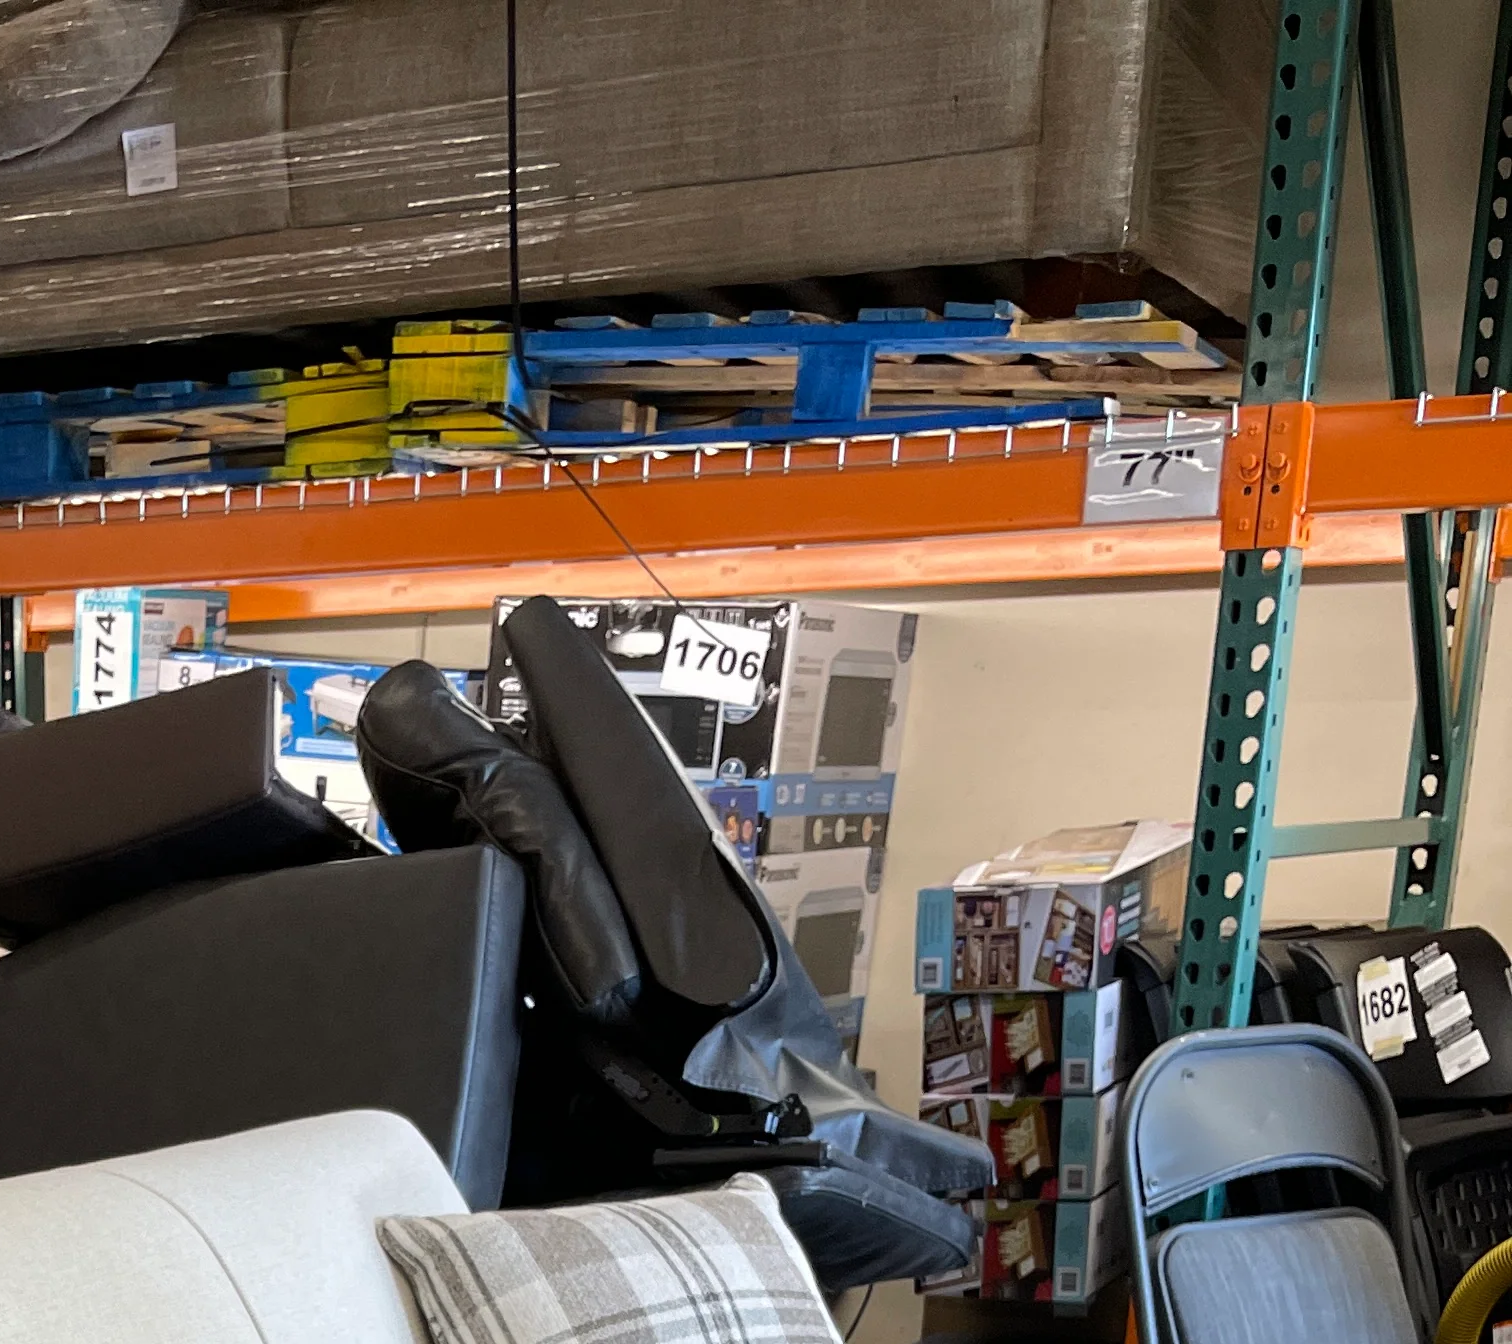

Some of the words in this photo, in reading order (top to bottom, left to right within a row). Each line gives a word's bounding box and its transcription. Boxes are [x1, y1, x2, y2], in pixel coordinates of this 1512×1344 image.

[1121, 449, 1196, 488] 77"
[93, 612, 116, 705] 1774
[179, 665, 191, 686] 8
[674, 637, 762, 681] 1706
[1361, 982, 1409, 1026] 1682
